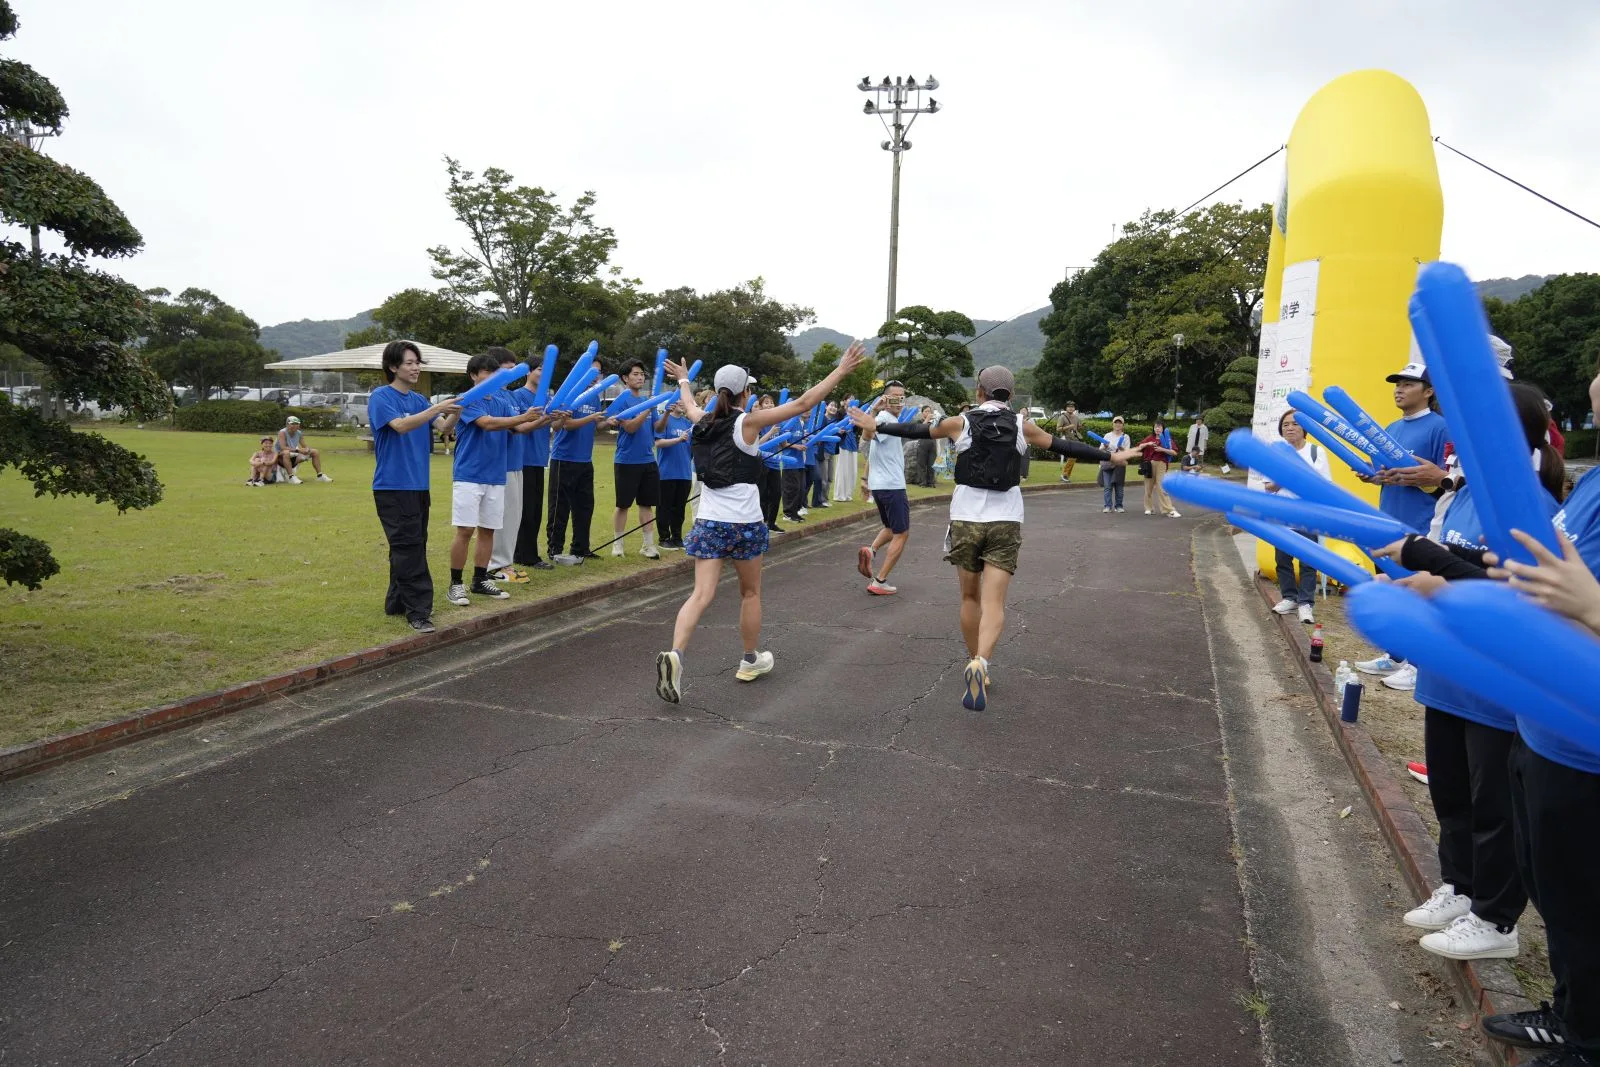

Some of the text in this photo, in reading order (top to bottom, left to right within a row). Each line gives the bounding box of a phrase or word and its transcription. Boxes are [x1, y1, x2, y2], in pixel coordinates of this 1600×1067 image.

[1334, 421, 1379, 456] 高砂熱学
[1364, 424, 1404, 461] 高砂熱学
